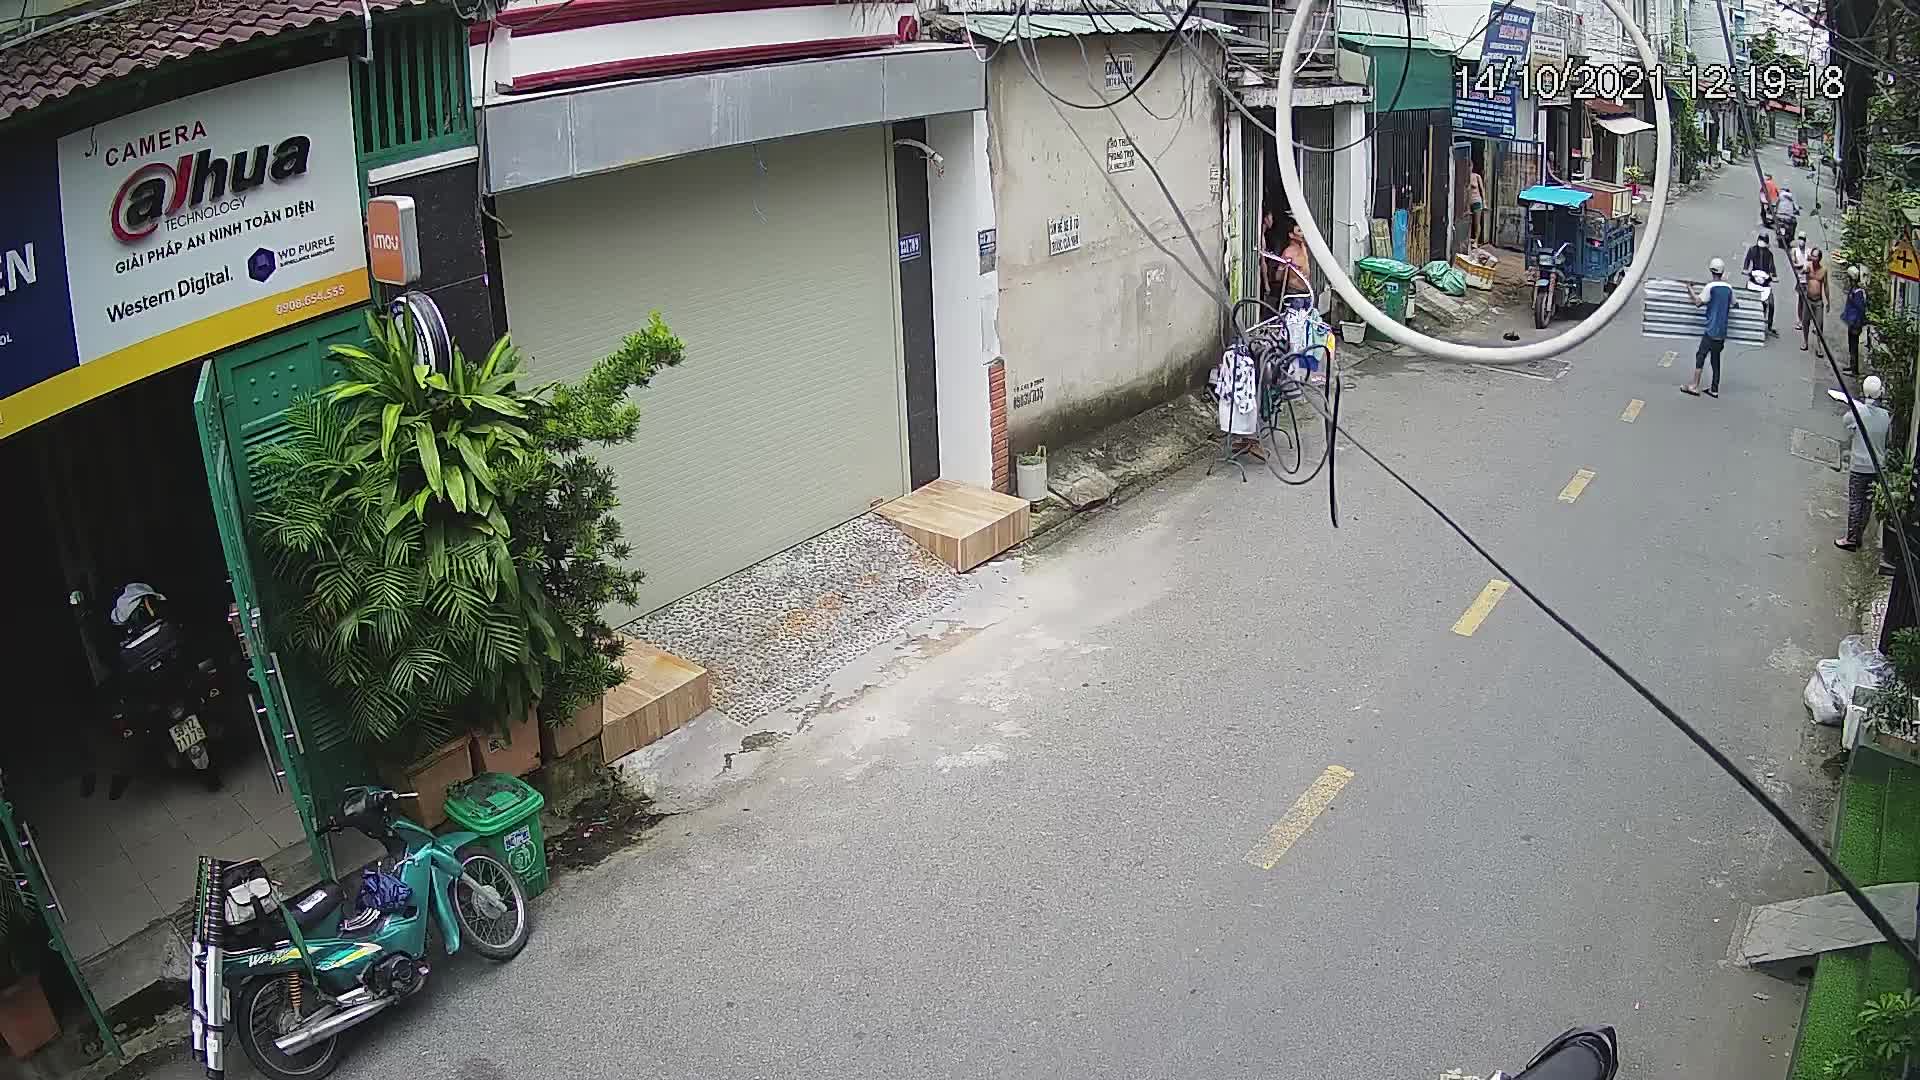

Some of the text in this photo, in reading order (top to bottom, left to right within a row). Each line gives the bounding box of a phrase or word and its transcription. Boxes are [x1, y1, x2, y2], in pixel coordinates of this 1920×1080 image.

[105, 120, 207, 166] CAMERA
[164, 195, 247, 231] TECHNOLOGY
[115, 199, 315, 273] GIẢI PHÁP AN NINH TOÀN DIỆN
[278, 247, 296, 259] WD
[298, 235, 335, 254] PURPLE
[106, 287, 175, 323] Western
